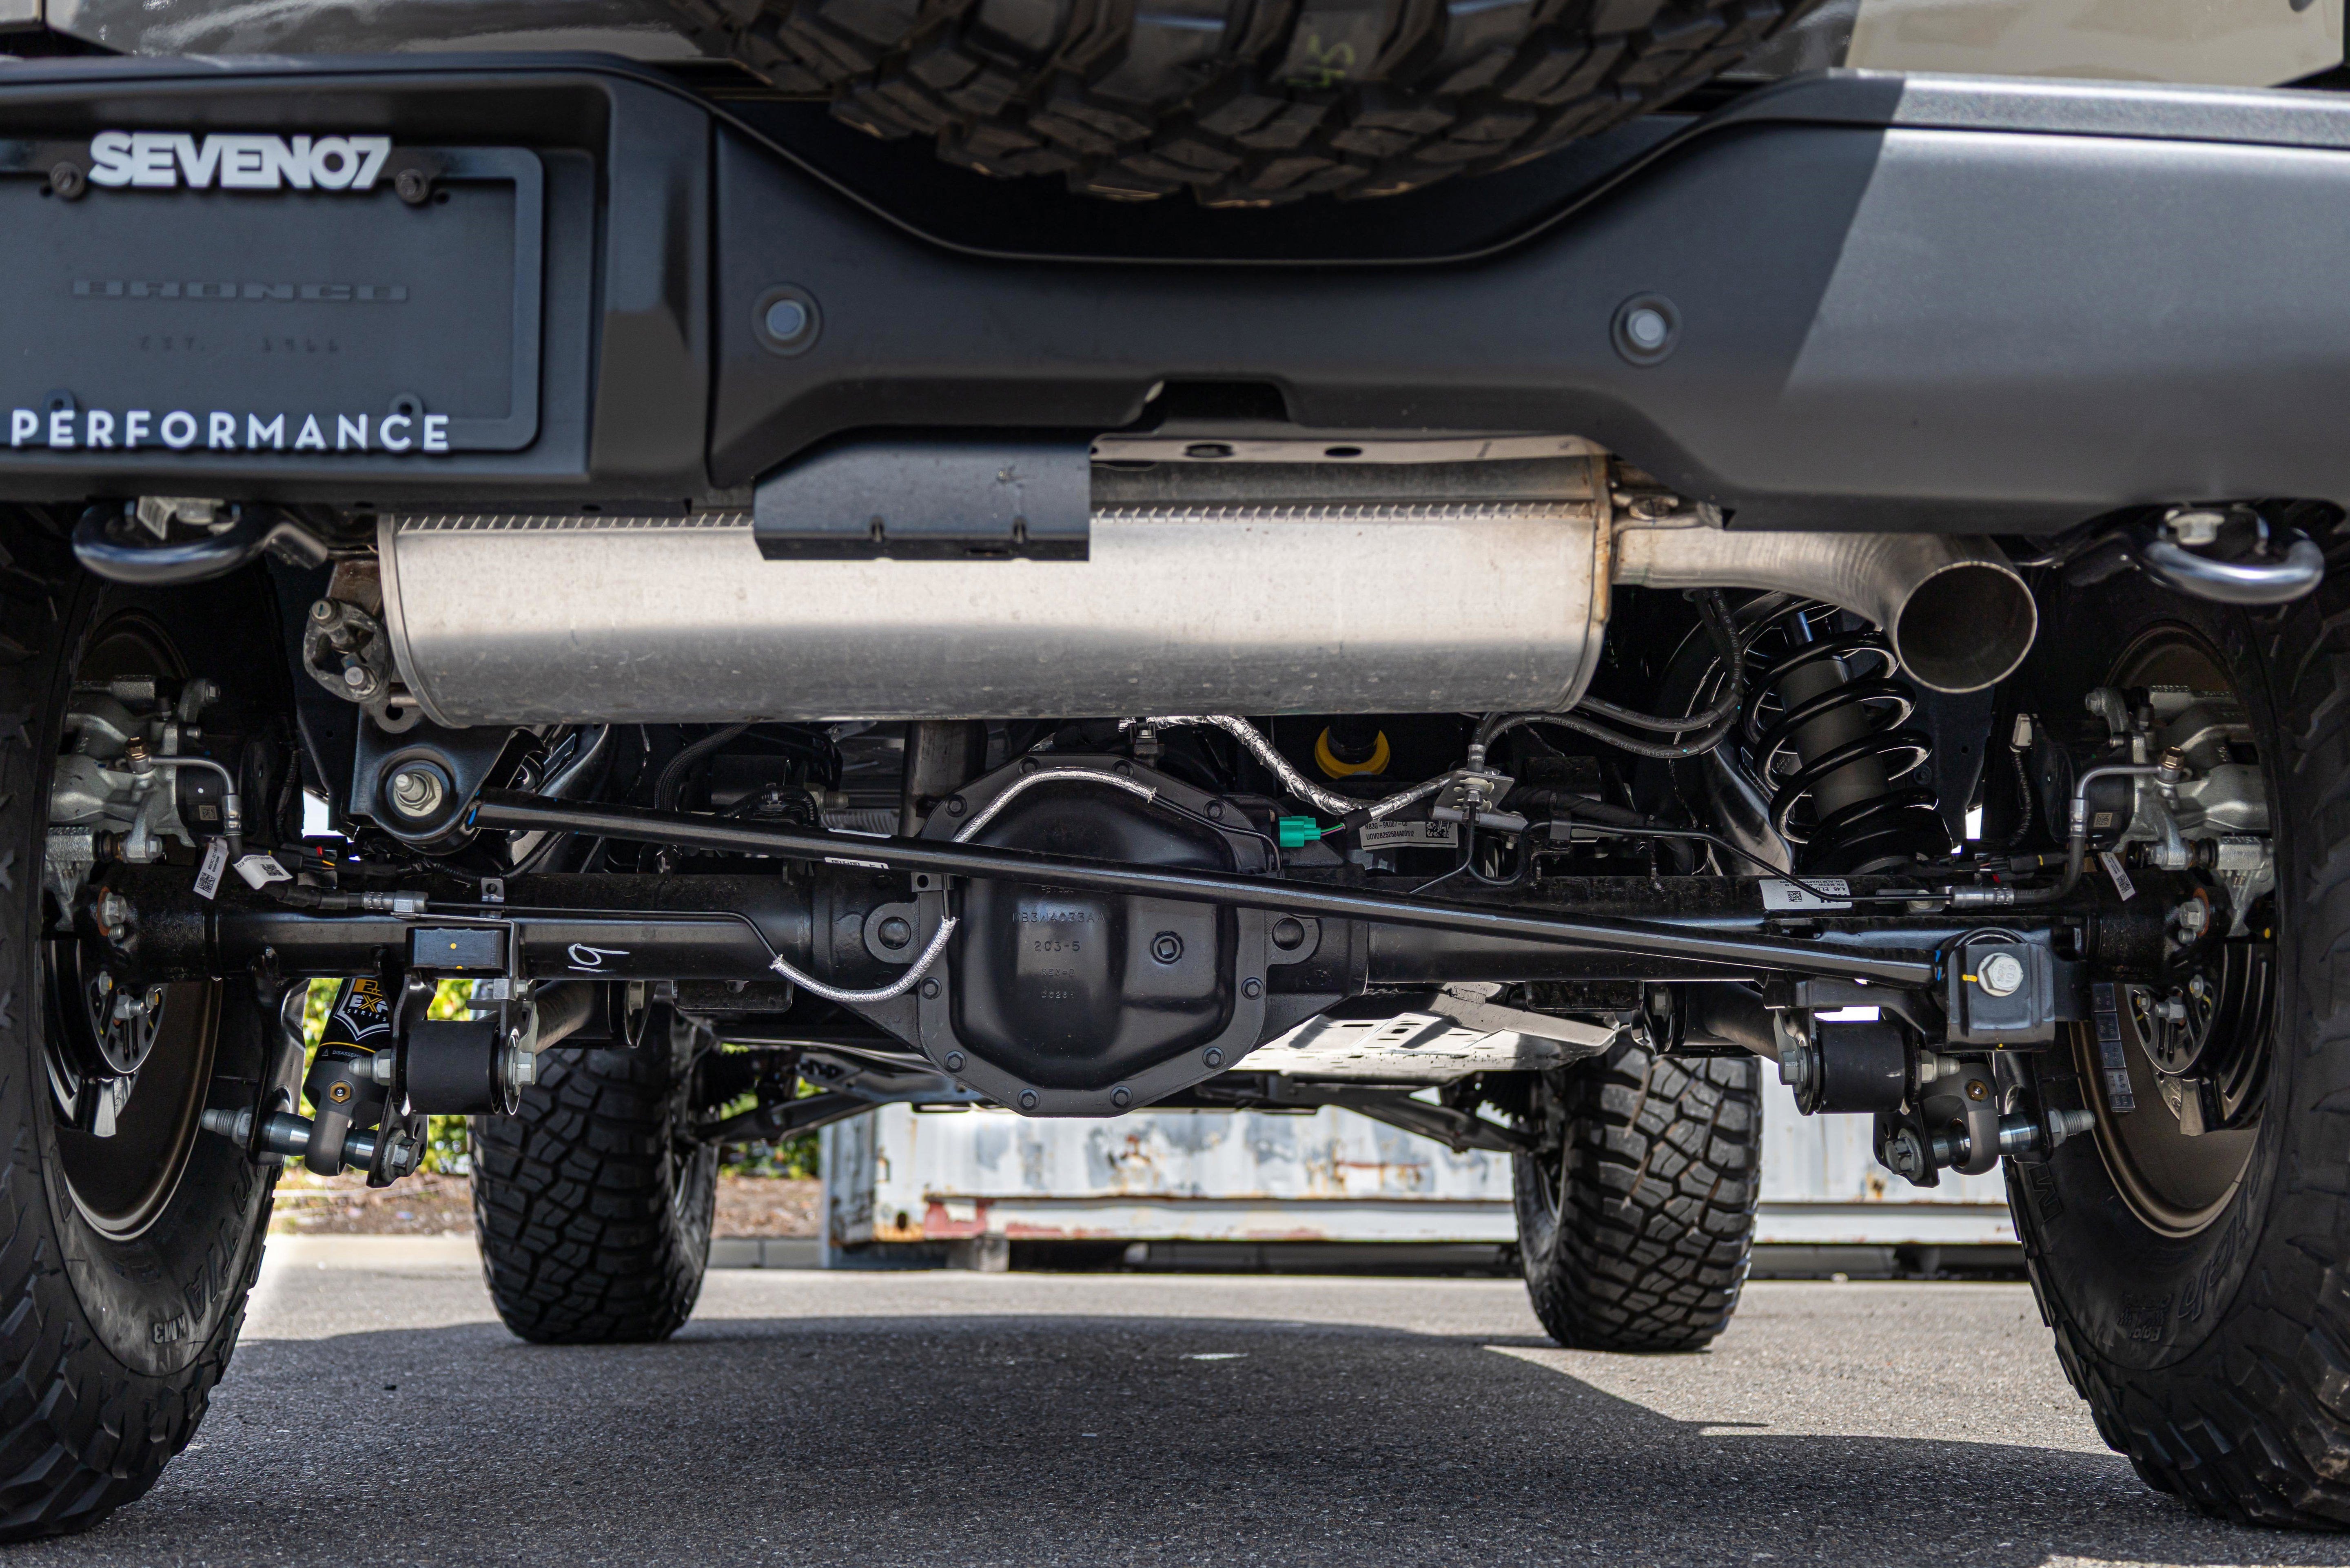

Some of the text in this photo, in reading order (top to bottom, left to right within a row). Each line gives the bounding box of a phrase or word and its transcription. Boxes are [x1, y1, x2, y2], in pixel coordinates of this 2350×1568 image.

[73, 279, 407, 301] BRONCO
[11, 409, 450, 453] PERFORMANCE
[1545, 716, 1583, 731] PROTERIAL
[1598, 734, 1611, 742] SAE
[1614, 740, 1636, 752] J1401
[1034, 941, 1081, 952] 203-5
[1041, 968, 1075, 976] REV-D
[347, 1009, 387, 1022] SERIES
